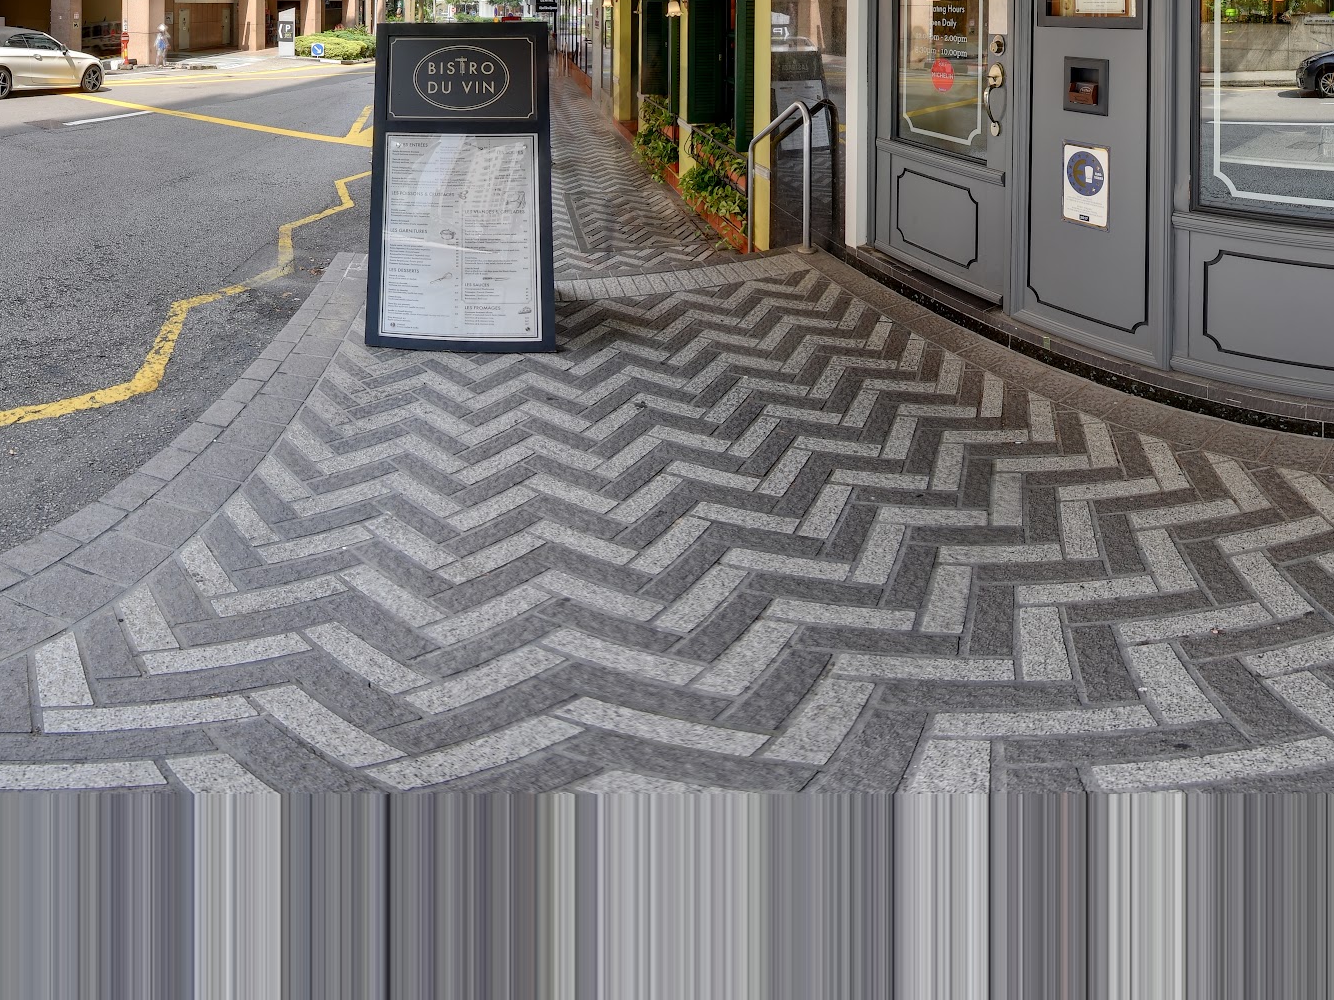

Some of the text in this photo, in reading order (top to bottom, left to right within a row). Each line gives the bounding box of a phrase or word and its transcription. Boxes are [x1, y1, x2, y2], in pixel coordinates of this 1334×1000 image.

[947, 4, 966, 13] Hours
[942, 18, 957, 29] Daily
[428, 56, 495, 76] BISTRO
[427, 81, 495, 94] DU VIN
